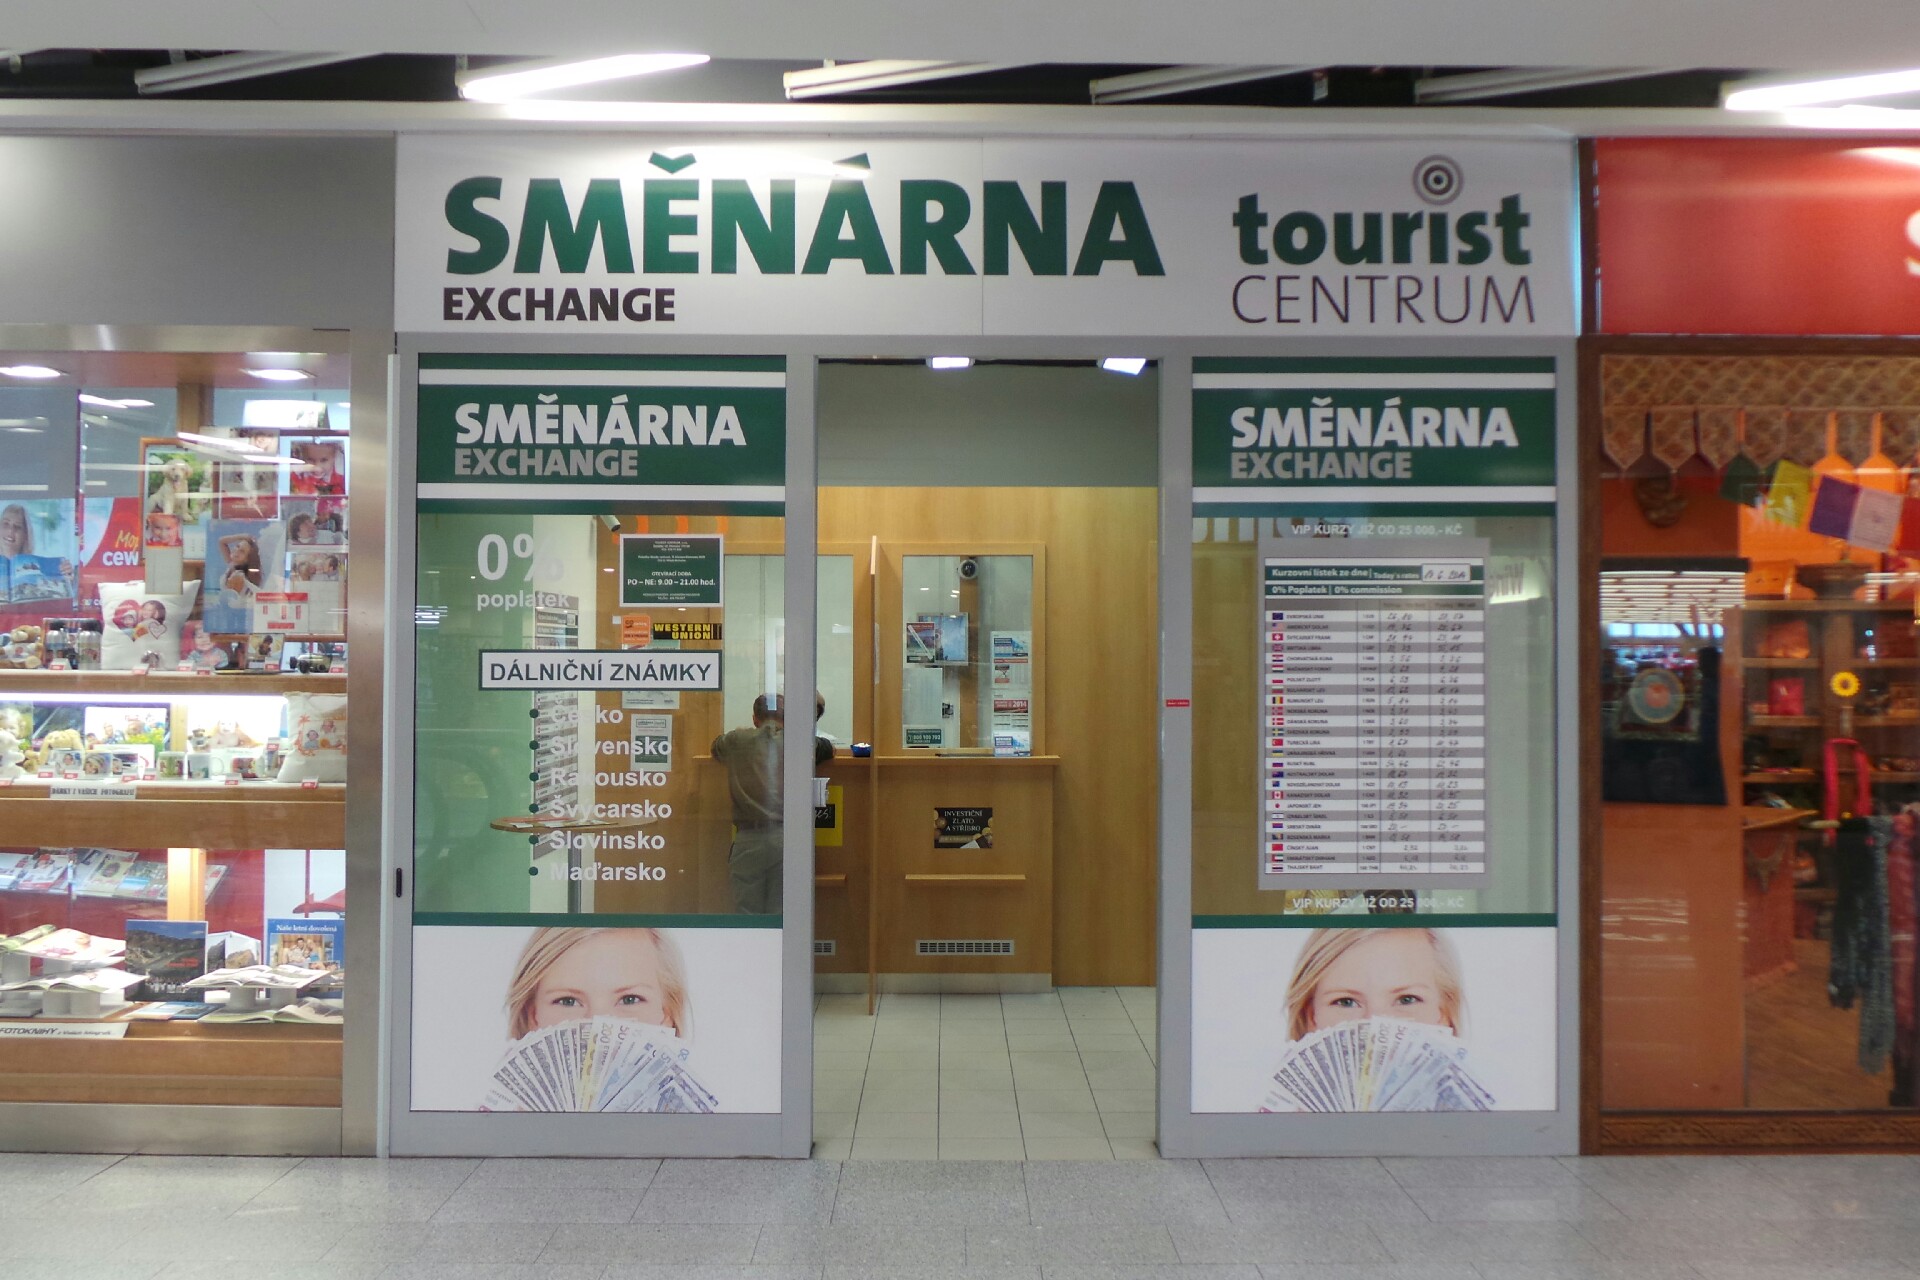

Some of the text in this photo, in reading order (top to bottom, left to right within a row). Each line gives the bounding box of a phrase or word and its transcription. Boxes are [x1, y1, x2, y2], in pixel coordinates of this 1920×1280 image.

[444, 151, 1166, 276] SMĚNÁRNA
[1232, 154, 1533, 265] tourist
[442, 287, 675, 321] EXCHANGE
[1232, 275, 1535, 323] CENTRUM
[455, 393, 747, 446] SMĚNÁRNA
[1230, 396, 1519, 448] SMĚNÁRNA
[455, 448, 638, 477] EXCHANGE
[1230, 451, 1412, 479] EXCHANGE
[1291, 525, 1311, 535] VIP
[1314, 525, 1354, 535] KURZY
[1377, 524, 1395, 535] OD
[1398, 524, 1412, 535] 25
[1445, 522, 1463, 535] KČ
[478, 533, 564, 583] 0%
[700, 578, 716, 586] hod.
[1272, 568, 1312, 577] Kurzovní
[1351, 568, 1368, 577] dne
[477, 590, 570, 611] poplatek
[1272, 586, 1403, 595] 0% Poplatek 0% commission
[654, 623, 711, 632] WESTERN
[671, 631, 711, 640] UNION
[490, 659, 712, 681] DÁLNIČNÍ ZNÁMKY
[550, 795, 672, 822] Švýcarsko
[944, 809, 983, 817] INVESTIČNÍ
[550, 830, 665, 849] Slovinsko
[551, 862, 666, 881] Maďarsko
[1293, 898, 1311, 908] VIP
[1379, 898, 1397, 908] OD
[1400, 898, 1414, 908] 25
